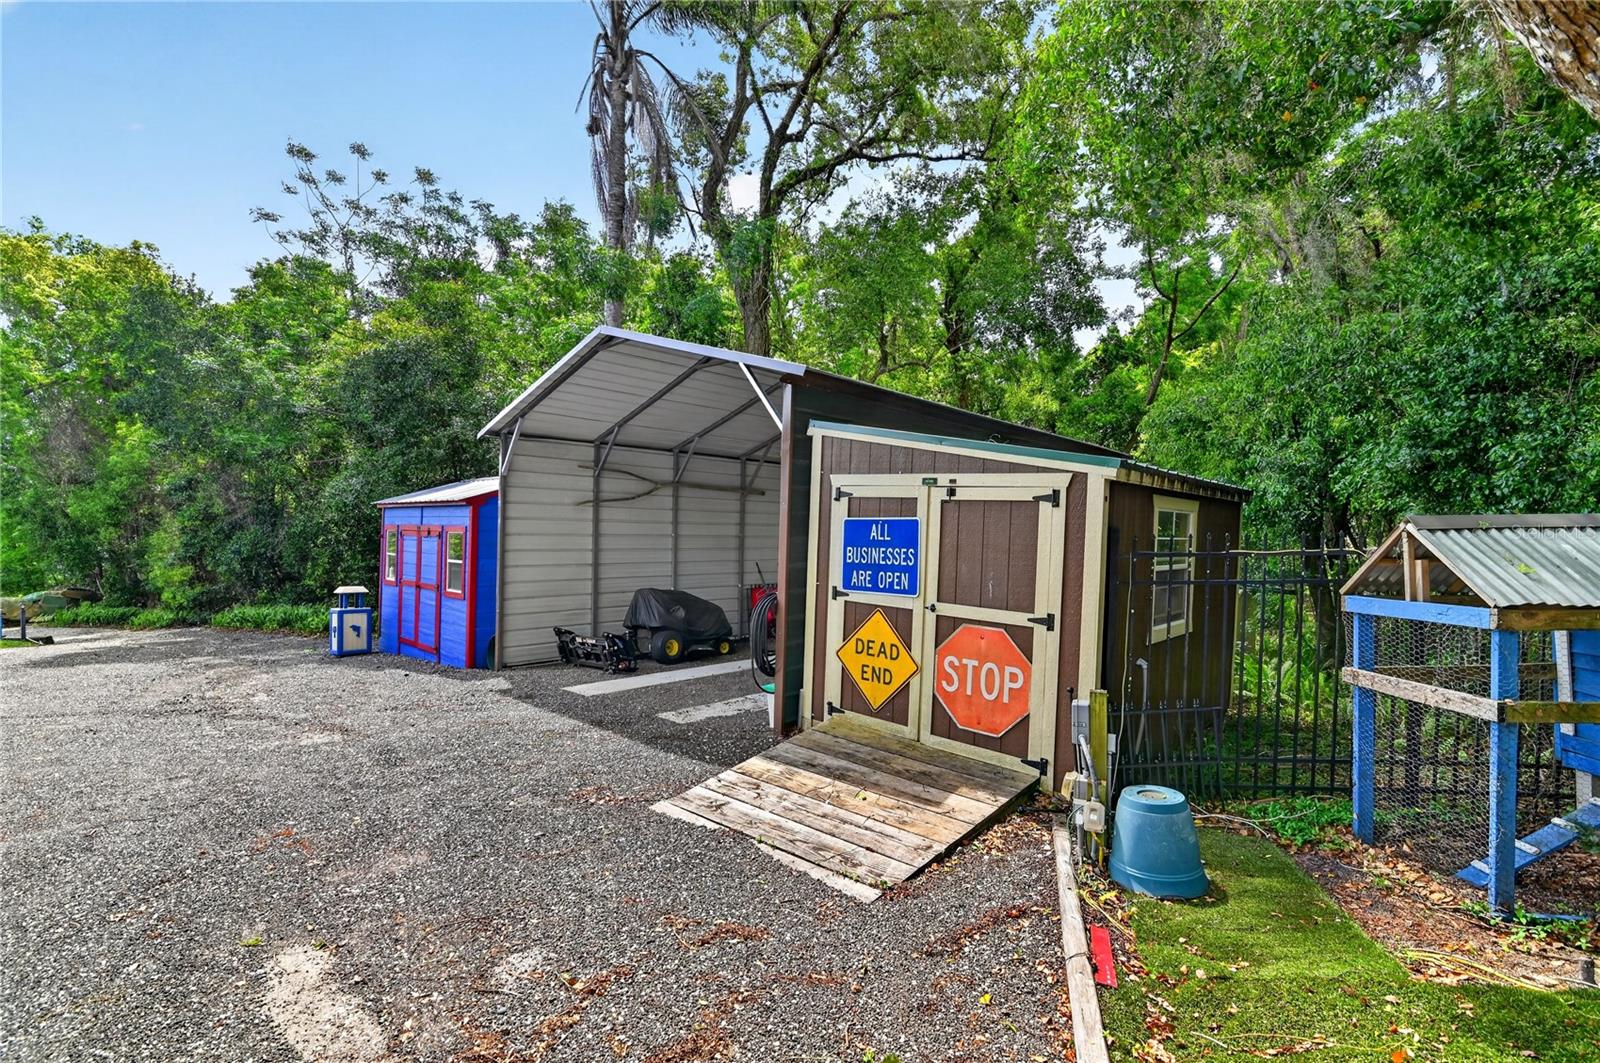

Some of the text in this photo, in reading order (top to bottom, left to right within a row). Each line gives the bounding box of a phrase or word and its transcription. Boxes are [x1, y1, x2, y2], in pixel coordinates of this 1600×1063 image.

[870, 524, 891, 541] ALL
[846, 547, 915, 566] BUSINESSES
[851, 570, 909, 590] ARE OPEN
[855, 638, 900, 660] DEAD
[861, 664, 893, 685] END
[941, 655, 1024, 704] STOP
